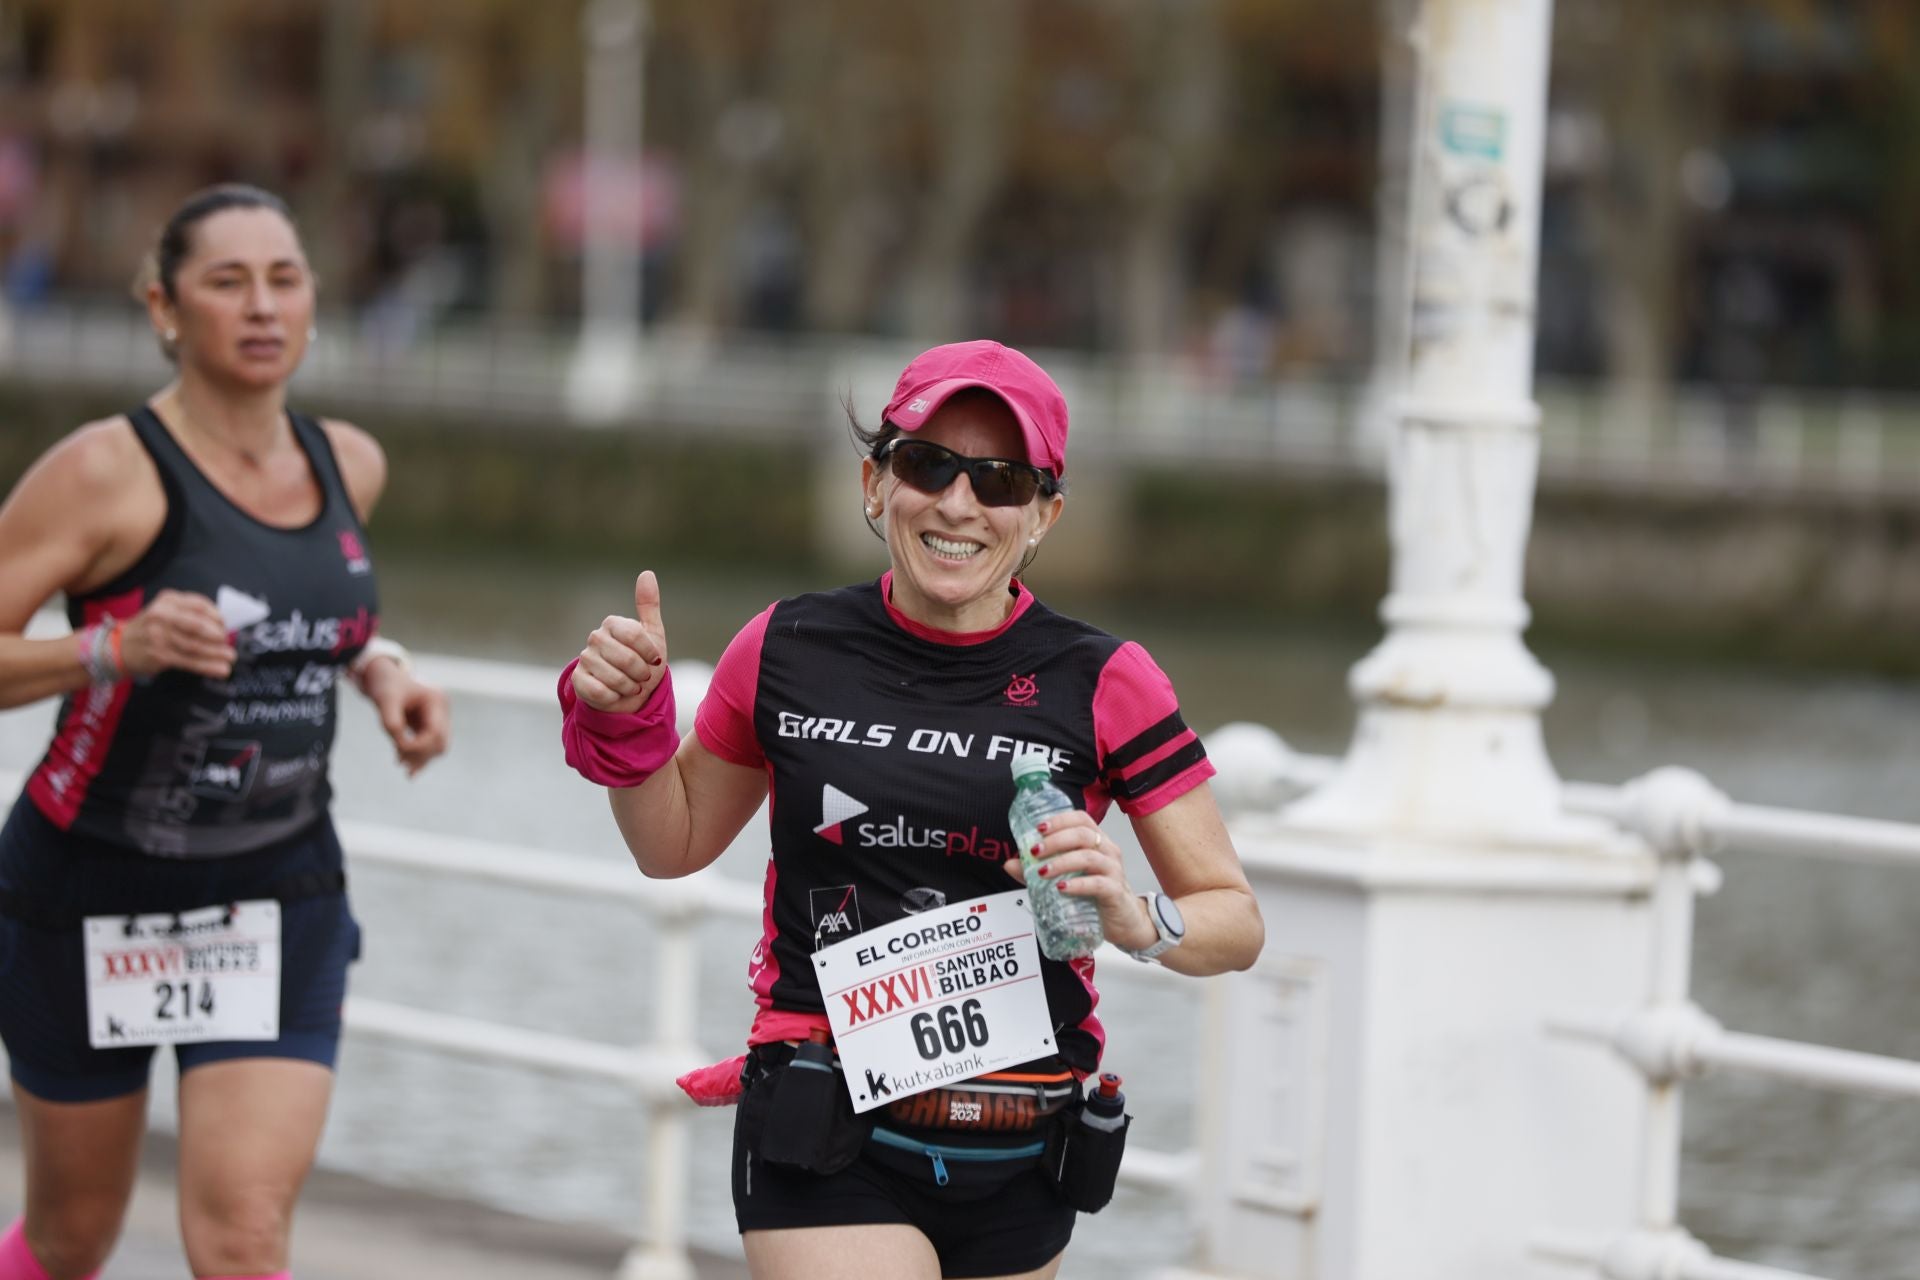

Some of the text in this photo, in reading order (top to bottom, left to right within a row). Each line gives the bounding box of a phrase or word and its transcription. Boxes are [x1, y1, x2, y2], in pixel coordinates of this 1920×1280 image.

[778, 711, 1075, 772] GIRLS ON FIRE
[818, 911, 853, 933] AXA
[856, 914, 982, 967] EL CORREO
[971, 931, 993, 943] VALOR
[935, 942, 1016, 976] SANTURCE
[939, 959, 1019, 996] BILBAO
[155, 981, 214, 1021] 214
[841, 966, 933, 1026] XXXVI
[910, 998, 989, 1060] 666
[892, 1052, 984, 1092] kutxabank
[950, 1109, 981, 1121] 2024
